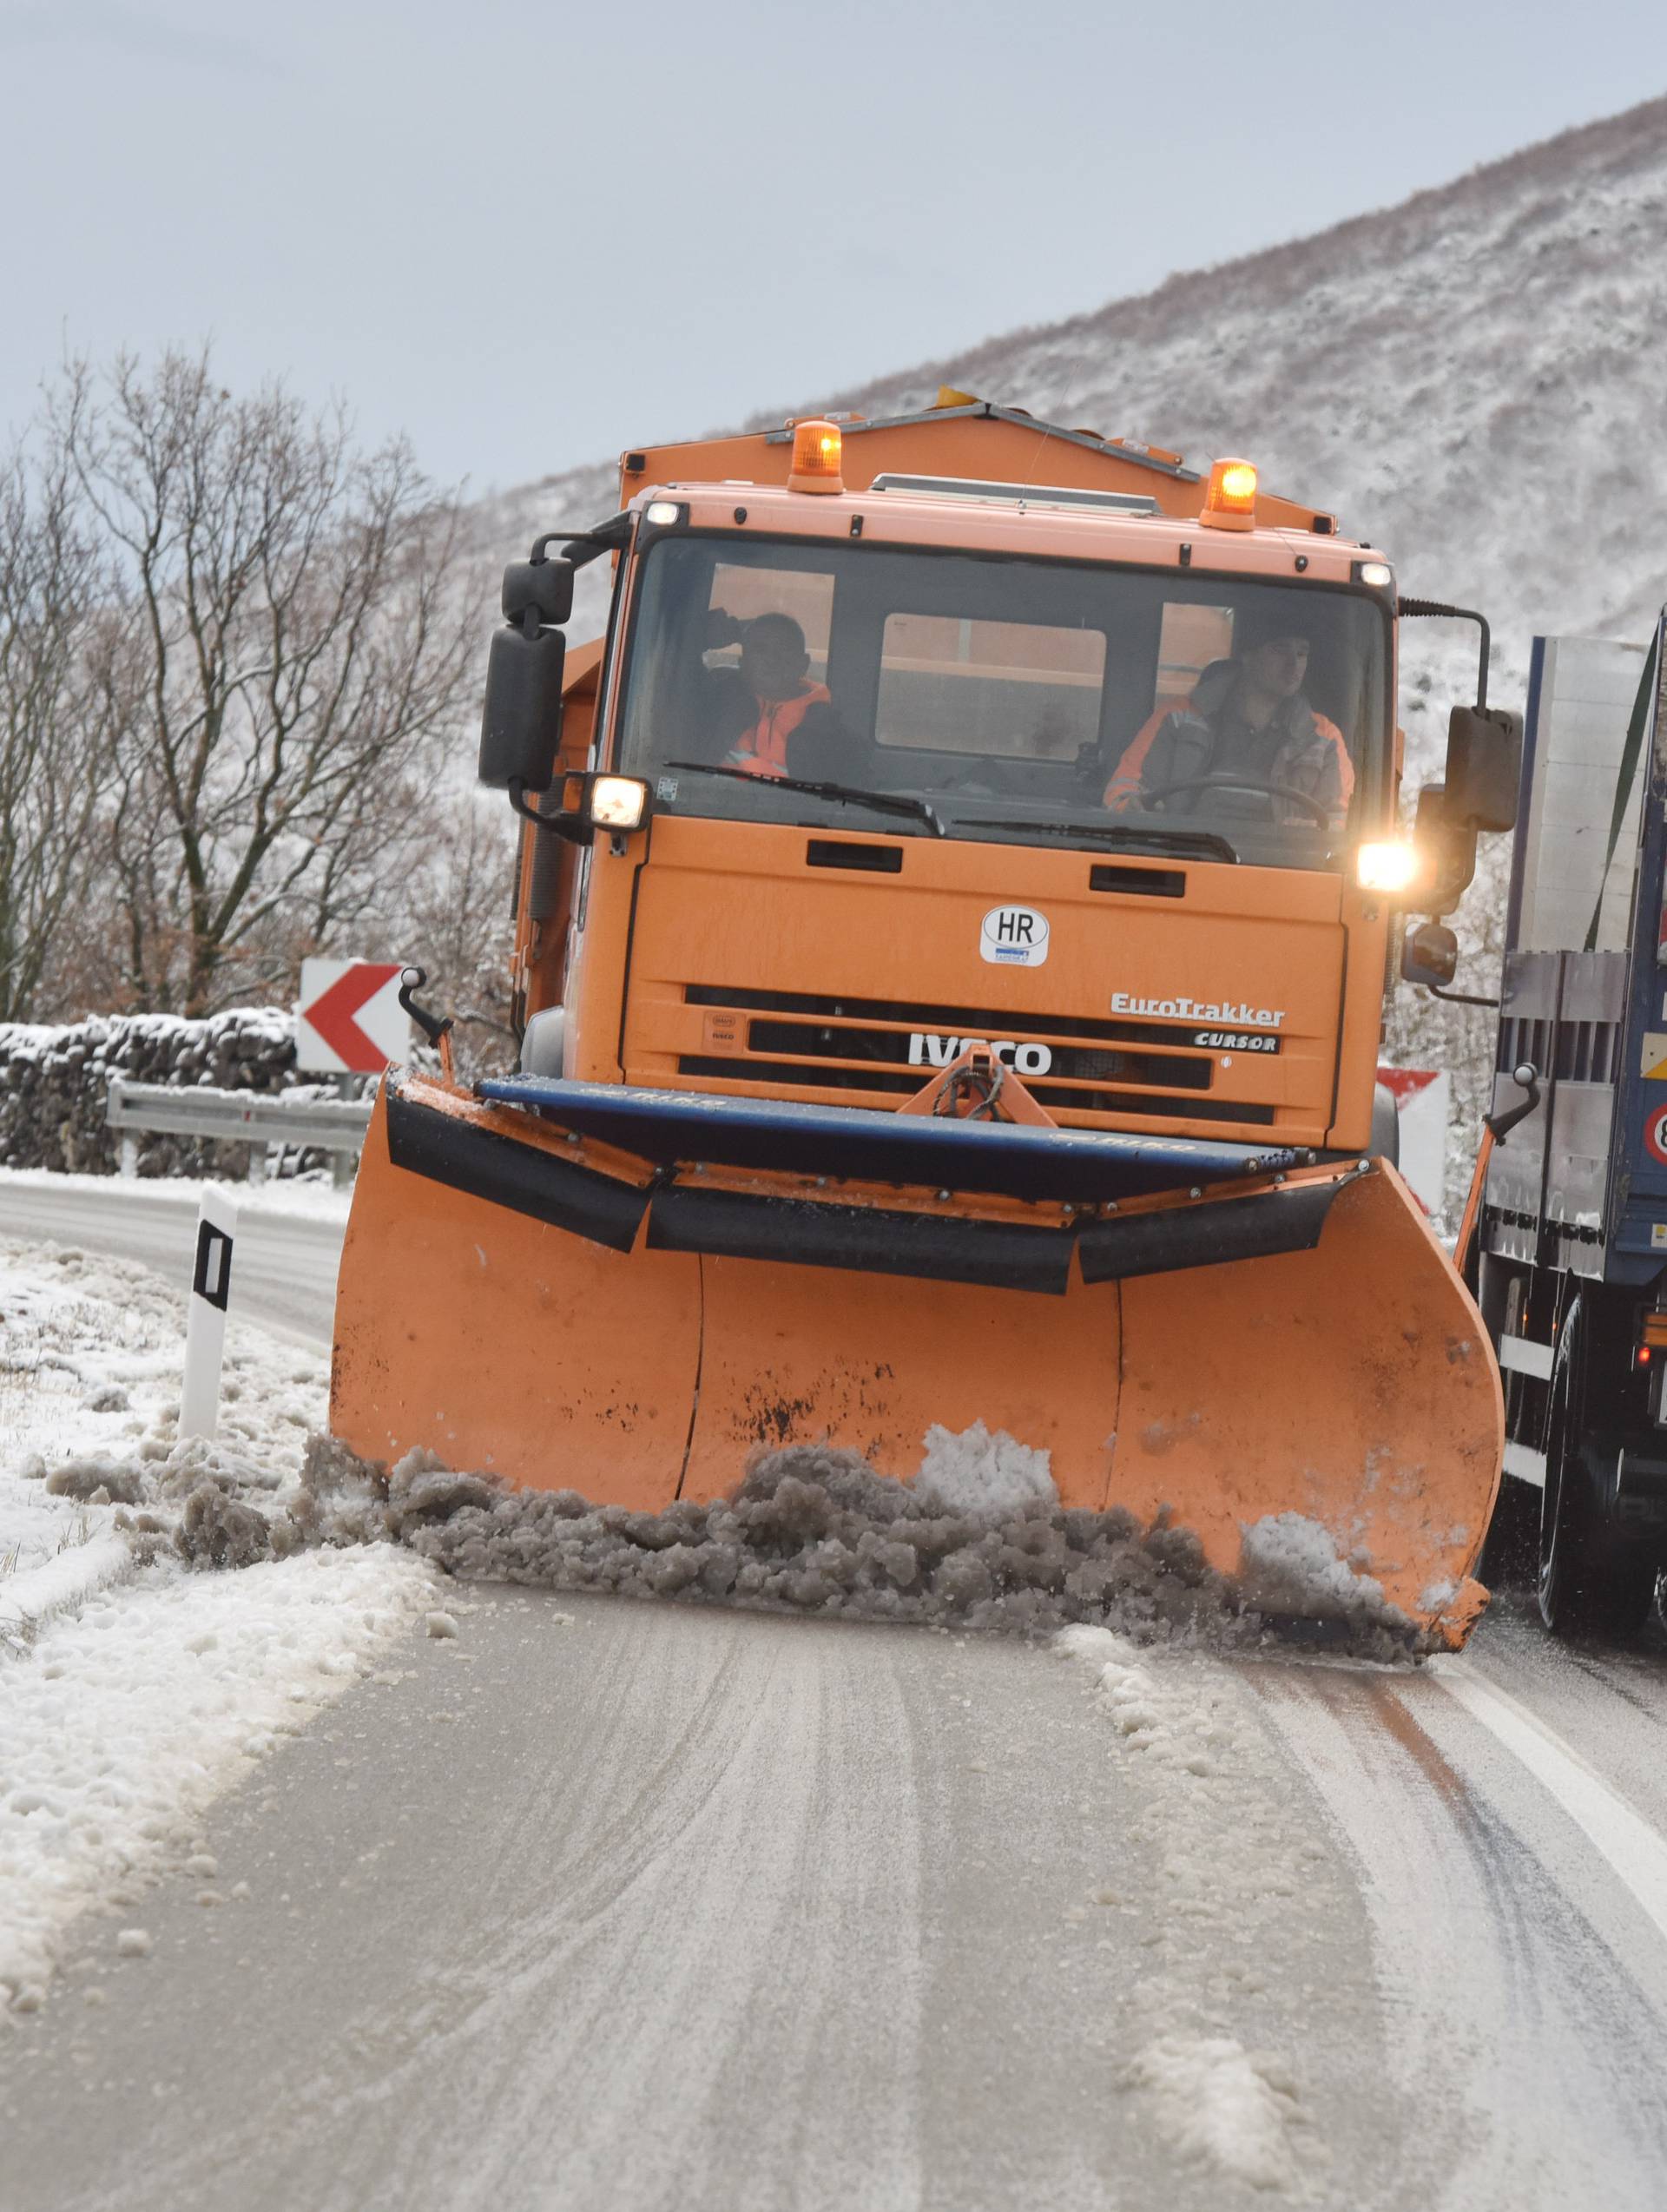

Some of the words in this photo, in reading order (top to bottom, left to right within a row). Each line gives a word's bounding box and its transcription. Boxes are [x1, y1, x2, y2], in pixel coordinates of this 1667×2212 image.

[998, 912, 1033, 944] HR
[1111, 992, 1285, 1028] EuroTrakker
[1195, 1032, 1276, 1051] CURSOR
